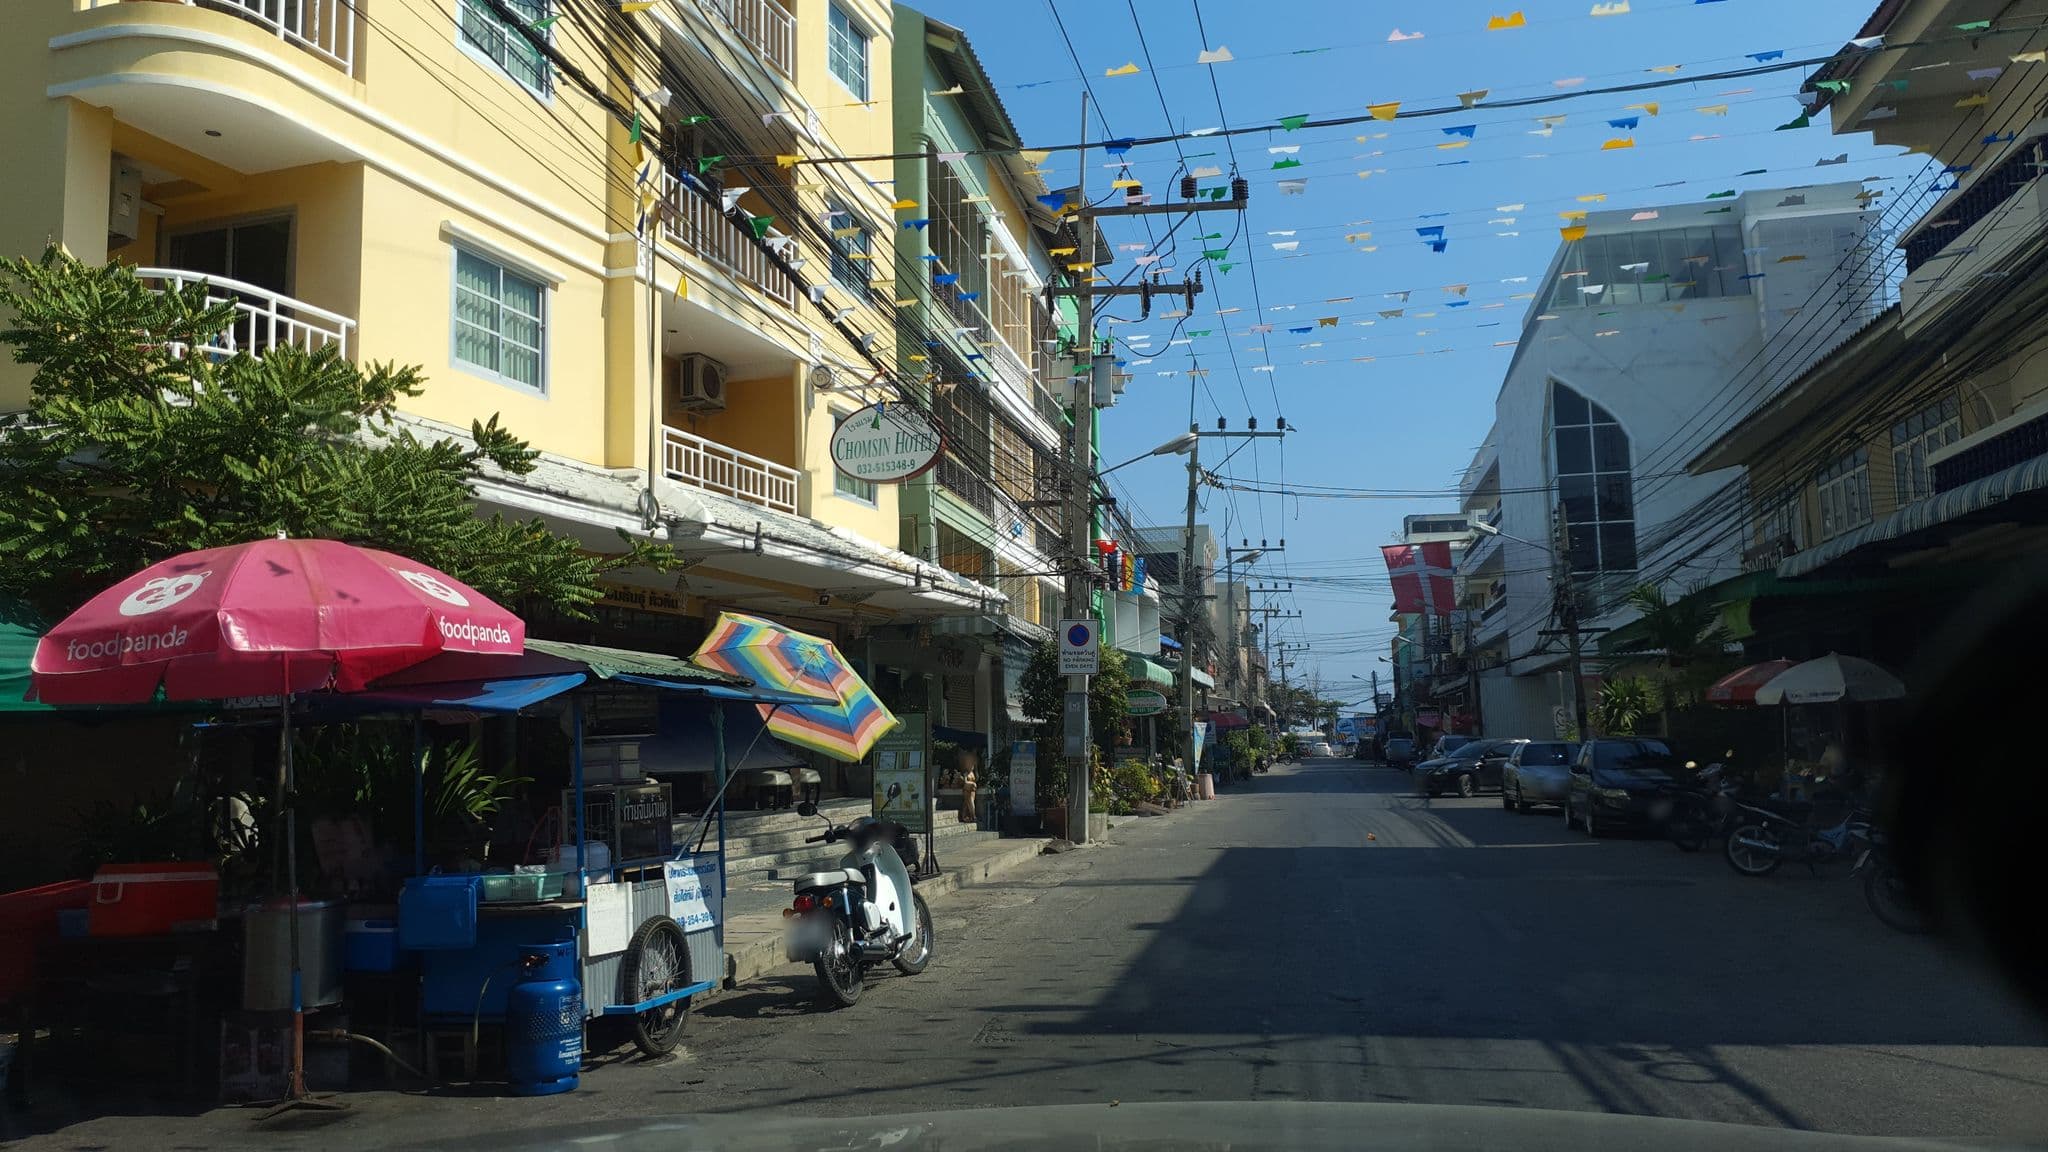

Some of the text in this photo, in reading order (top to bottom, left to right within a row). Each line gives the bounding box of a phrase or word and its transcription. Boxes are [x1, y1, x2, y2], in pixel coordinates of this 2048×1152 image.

[836, 431, 936, 461] CHOMSIN HOTEL
[857, 459, 915, 474] 032-515348-9
[67, 625, 188, 661] foodpanda
[439, 615, 511, 647] foodpanda
